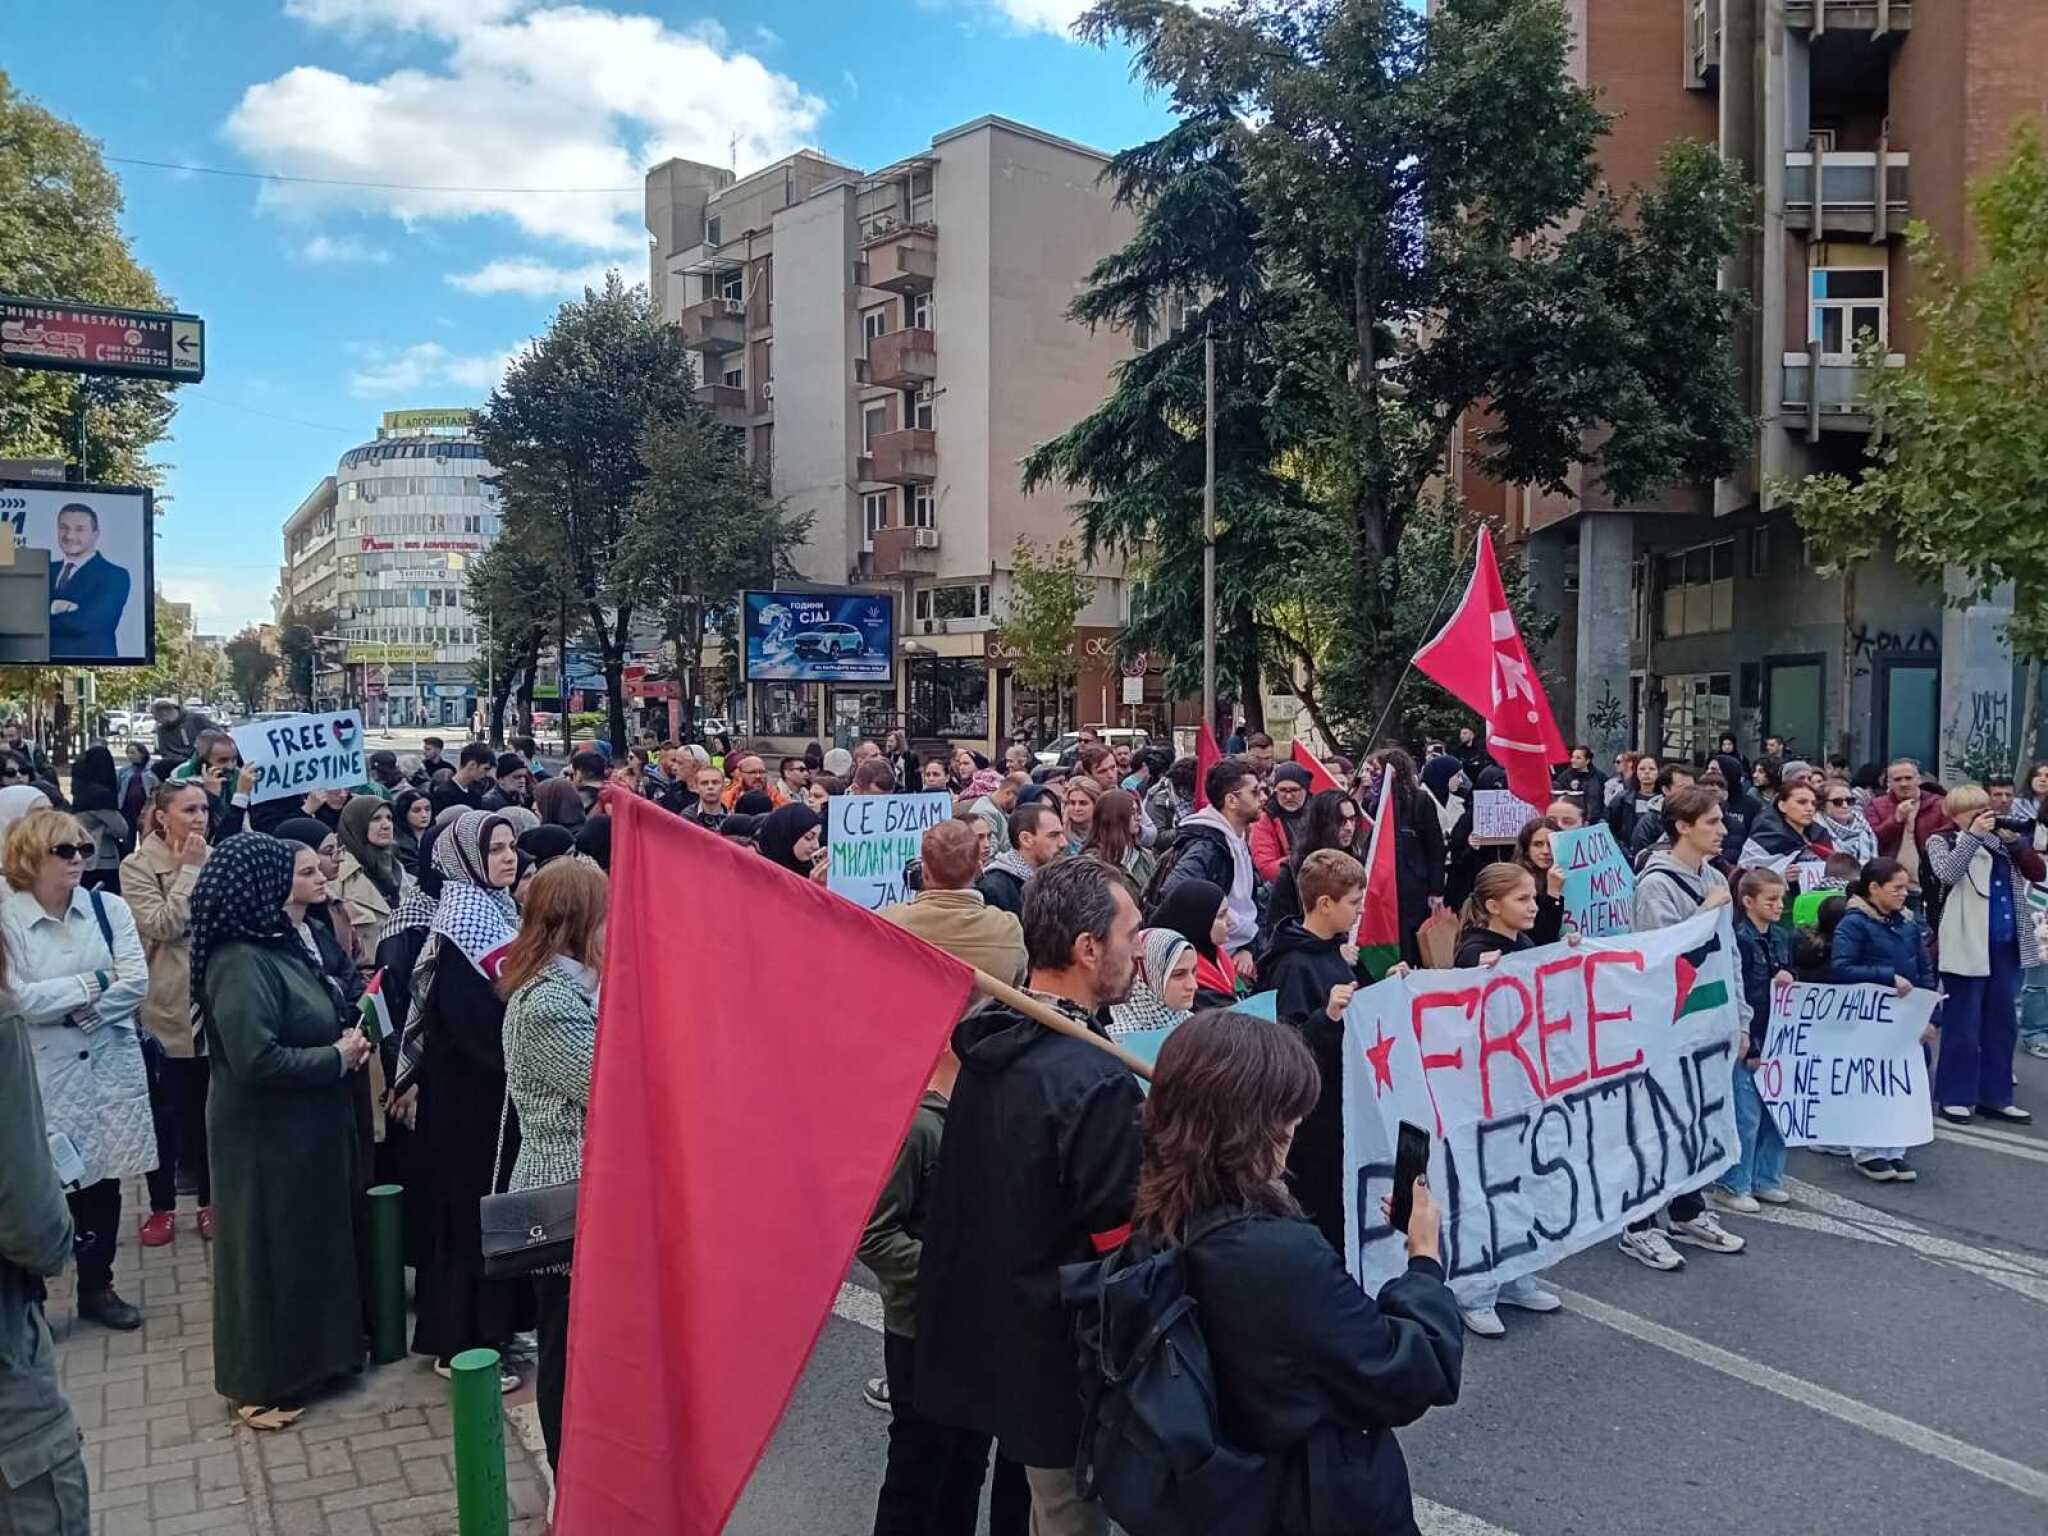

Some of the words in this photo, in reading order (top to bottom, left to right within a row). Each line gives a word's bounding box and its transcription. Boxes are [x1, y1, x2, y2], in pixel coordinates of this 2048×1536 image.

[71, 311, 168, 331] RESTAURANT
[790, 601, 824, 610] ГОДИНИ
[266, 723, 327, 758] FREE
[254, 750, 362, 794] PALESTINE
[843, 801, 874, 835] СЕ
[885, 800, 942, 832] БУДАМ
[1800, 986, 1836, 1021] ВО
[1411, 950, 1645, 1138] FREE
[1767, 1023, 1813, 1060] ИМЕ
[1830, 1058, 1912, 1098] EMRIN
[1357, 1040, 1733, 1292] PLESTINE
